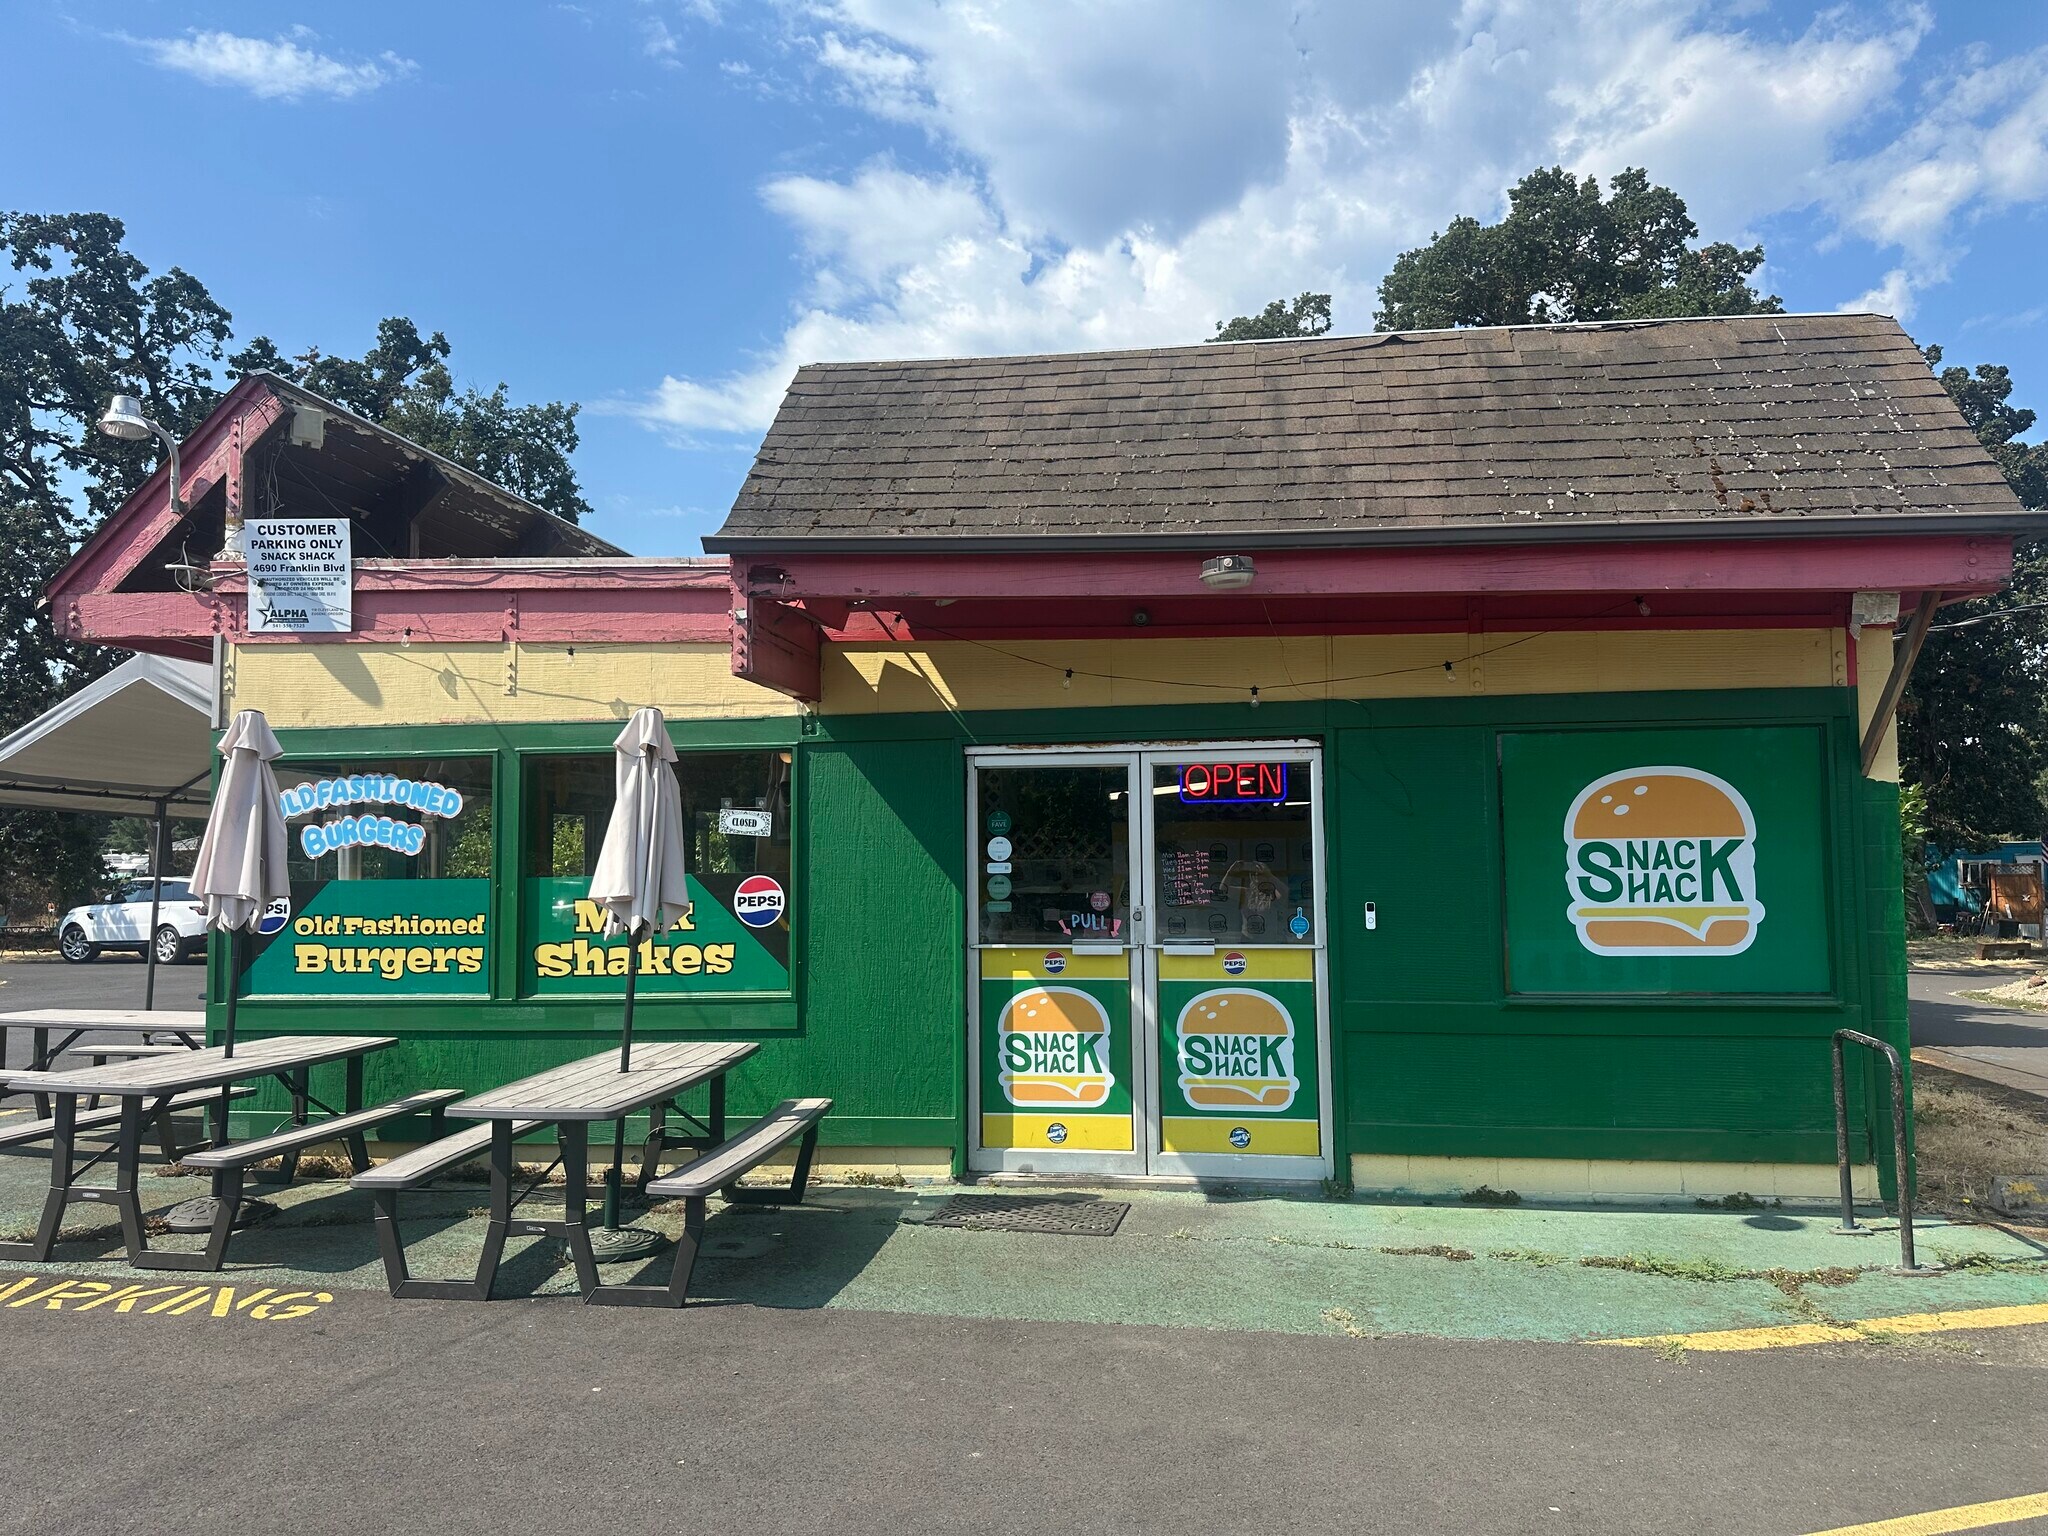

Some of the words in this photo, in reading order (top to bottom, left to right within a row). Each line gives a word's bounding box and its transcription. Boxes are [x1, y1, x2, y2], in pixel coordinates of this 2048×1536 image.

[257, 524, 337, 536] CUSTOMER
[251, 540, 306, 549] PARKING
[310, 540, 343, 549] ONLY
[260, 552, 296, 561] SNACK
[299, 552, 335, 560] SHACK
[253, 564, 277, 572] 4690
[280, 564, 320, 572] Franklin
[324, 564, 345, 572] Blvd
[1185, 764, 1282, 796] OPEN
[732, 818, 757, 828] CLOSED
[303, 814, 424, 856] BURGERS
[737, 896, 782, 907] PEPSI
[265, 904, 288, 914] PSI
[294, 914, 340, 936] Old
[343, 914, 485, 936] Fashioned
[1071, 912, 1108, 931] PULL
[294, 944, 484, 980] Burgers
[534, 939, 736, 977] Shakes
